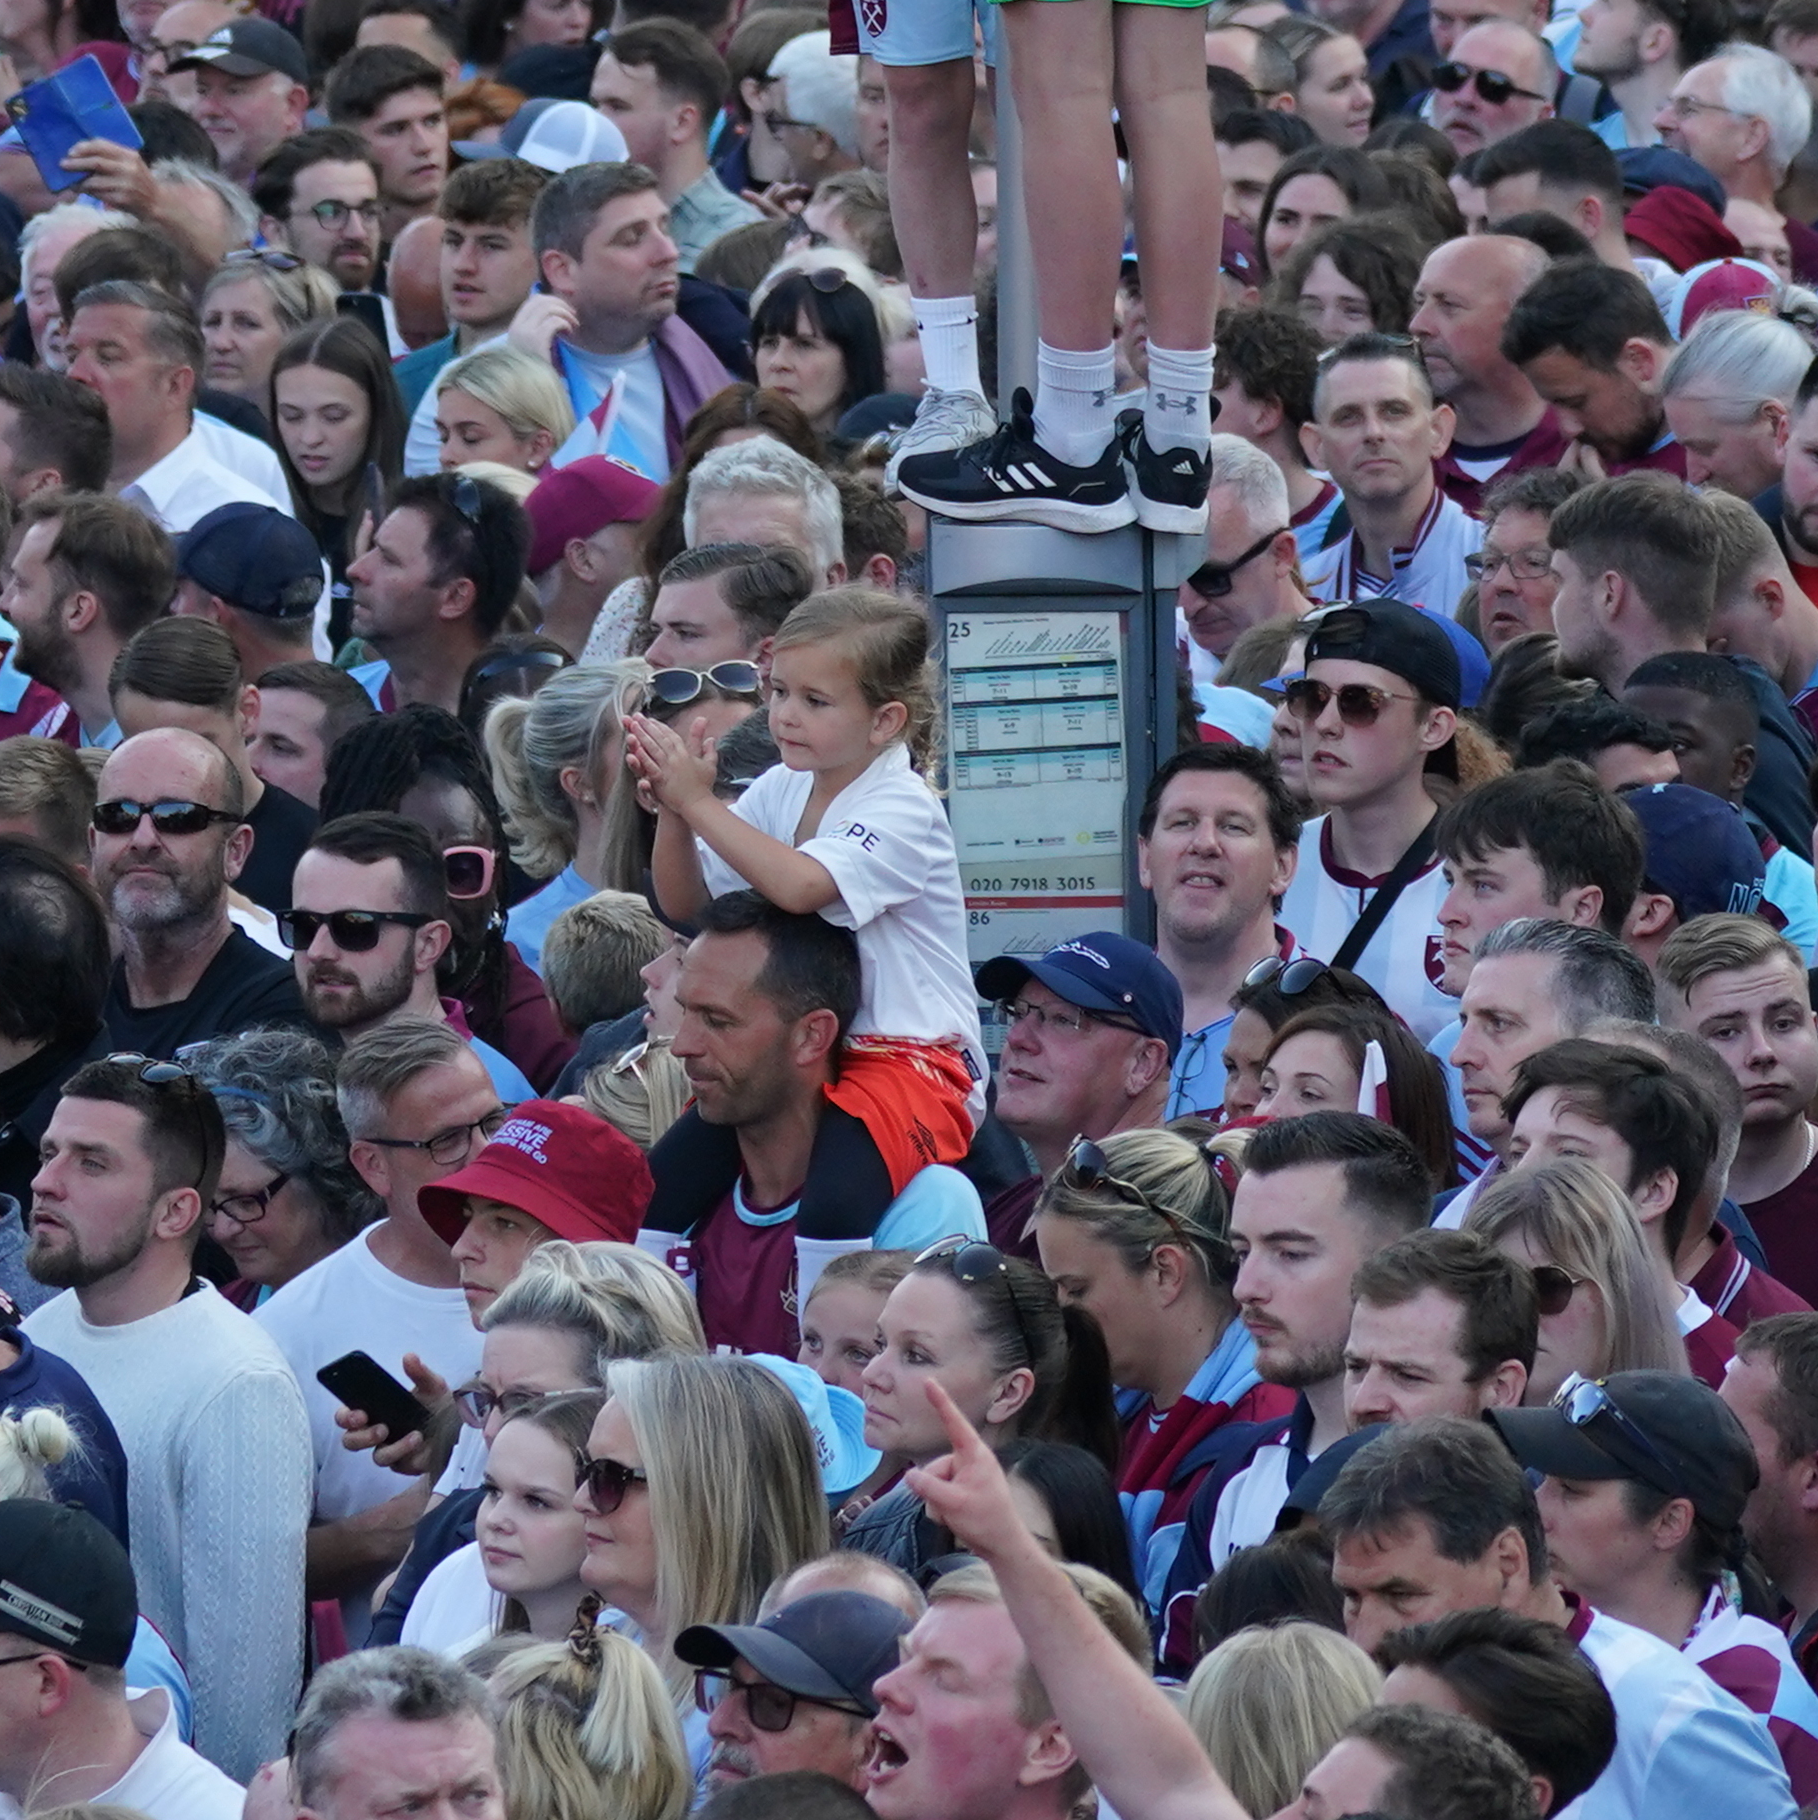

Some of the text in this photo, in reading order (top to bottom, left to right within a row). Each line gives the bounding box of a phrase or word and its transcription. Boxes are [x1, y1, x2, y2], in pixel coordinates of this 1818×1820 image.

[948, 622, 971, 638] 25
[970, 877, 1096, 891] 020 7918 3015
[969, 911, 991, 925] 86
